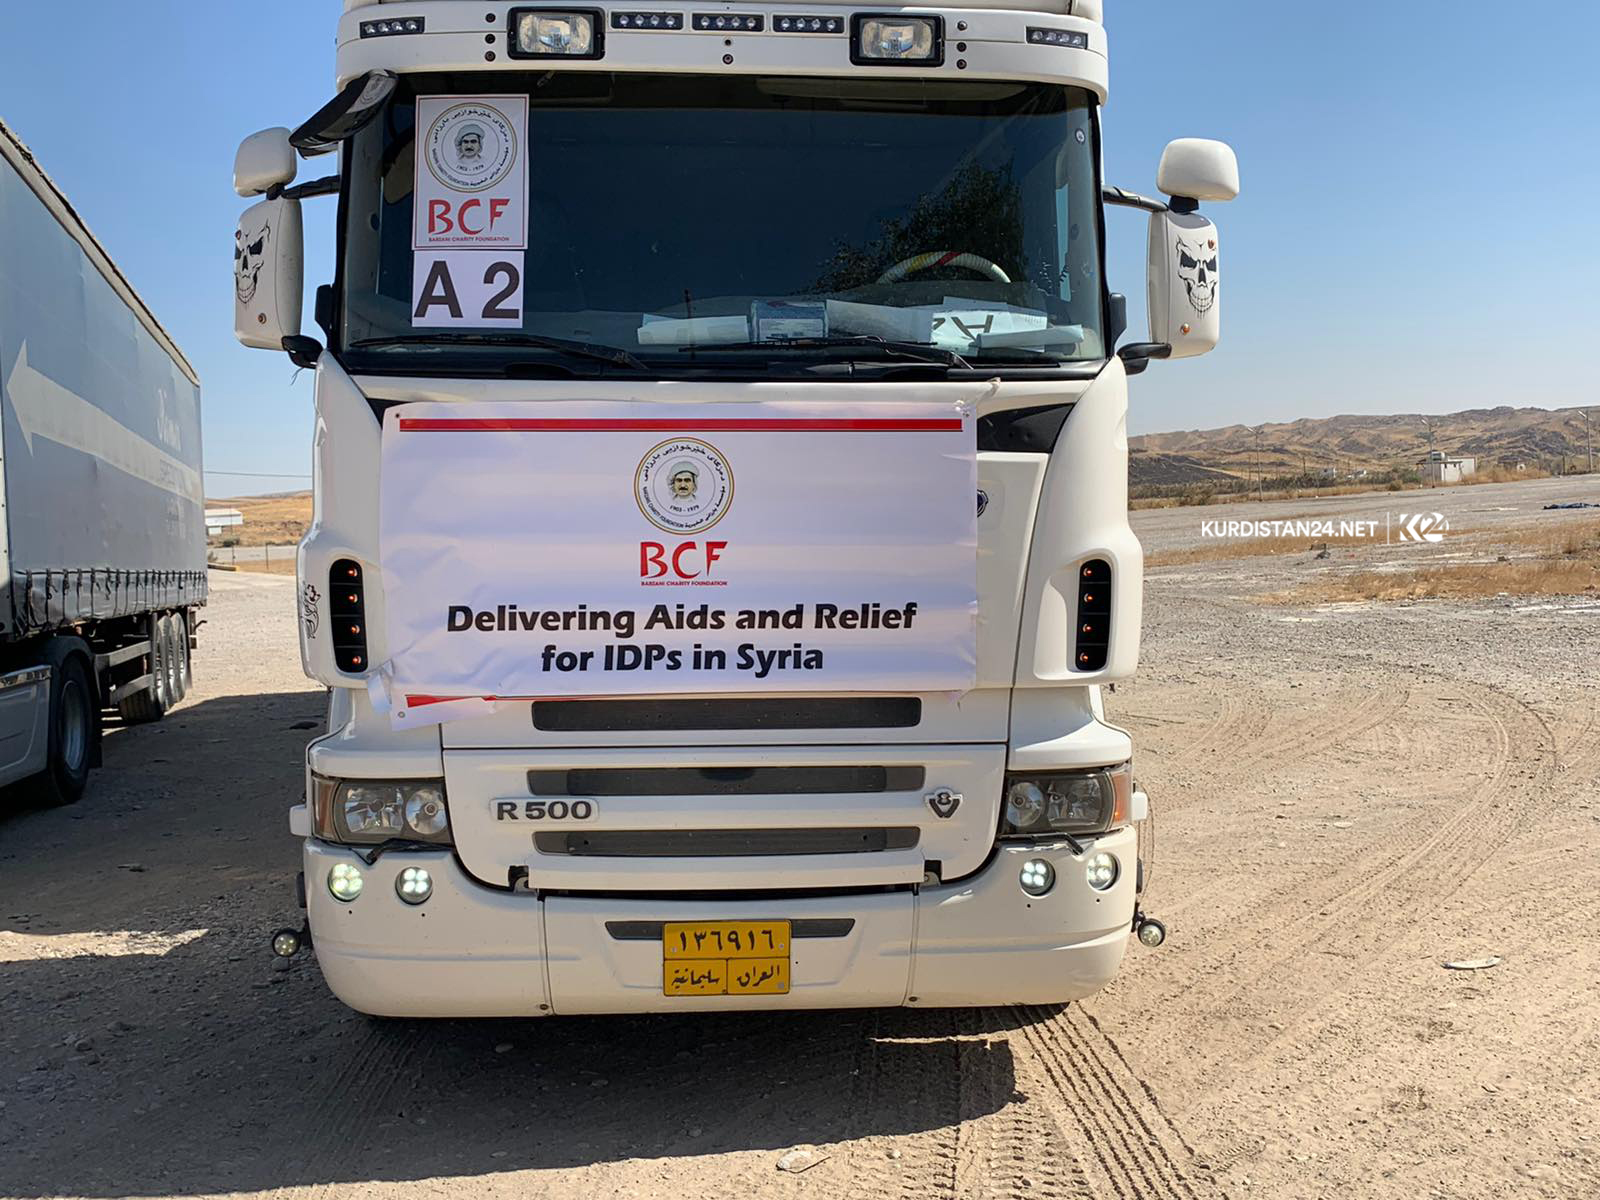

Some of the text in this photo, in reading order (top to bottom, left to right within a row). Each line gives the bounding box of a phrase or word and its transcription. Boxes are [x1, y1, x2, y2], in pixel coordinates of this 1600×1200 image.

[428, 198, 511, 235] BCF
[413, 260, 520, 319] A 2
[640, 541, 728, 579] BCF
[447, 602, 918, 638] Delivering Aids and Relief
[541, 643, 823, 678] for IDPs in Syria
[497, 800, 592, 820] R 500
[680, 929, 774, 951] ١٣٦٩١٦
[737, 965, 780, 987] العراق
